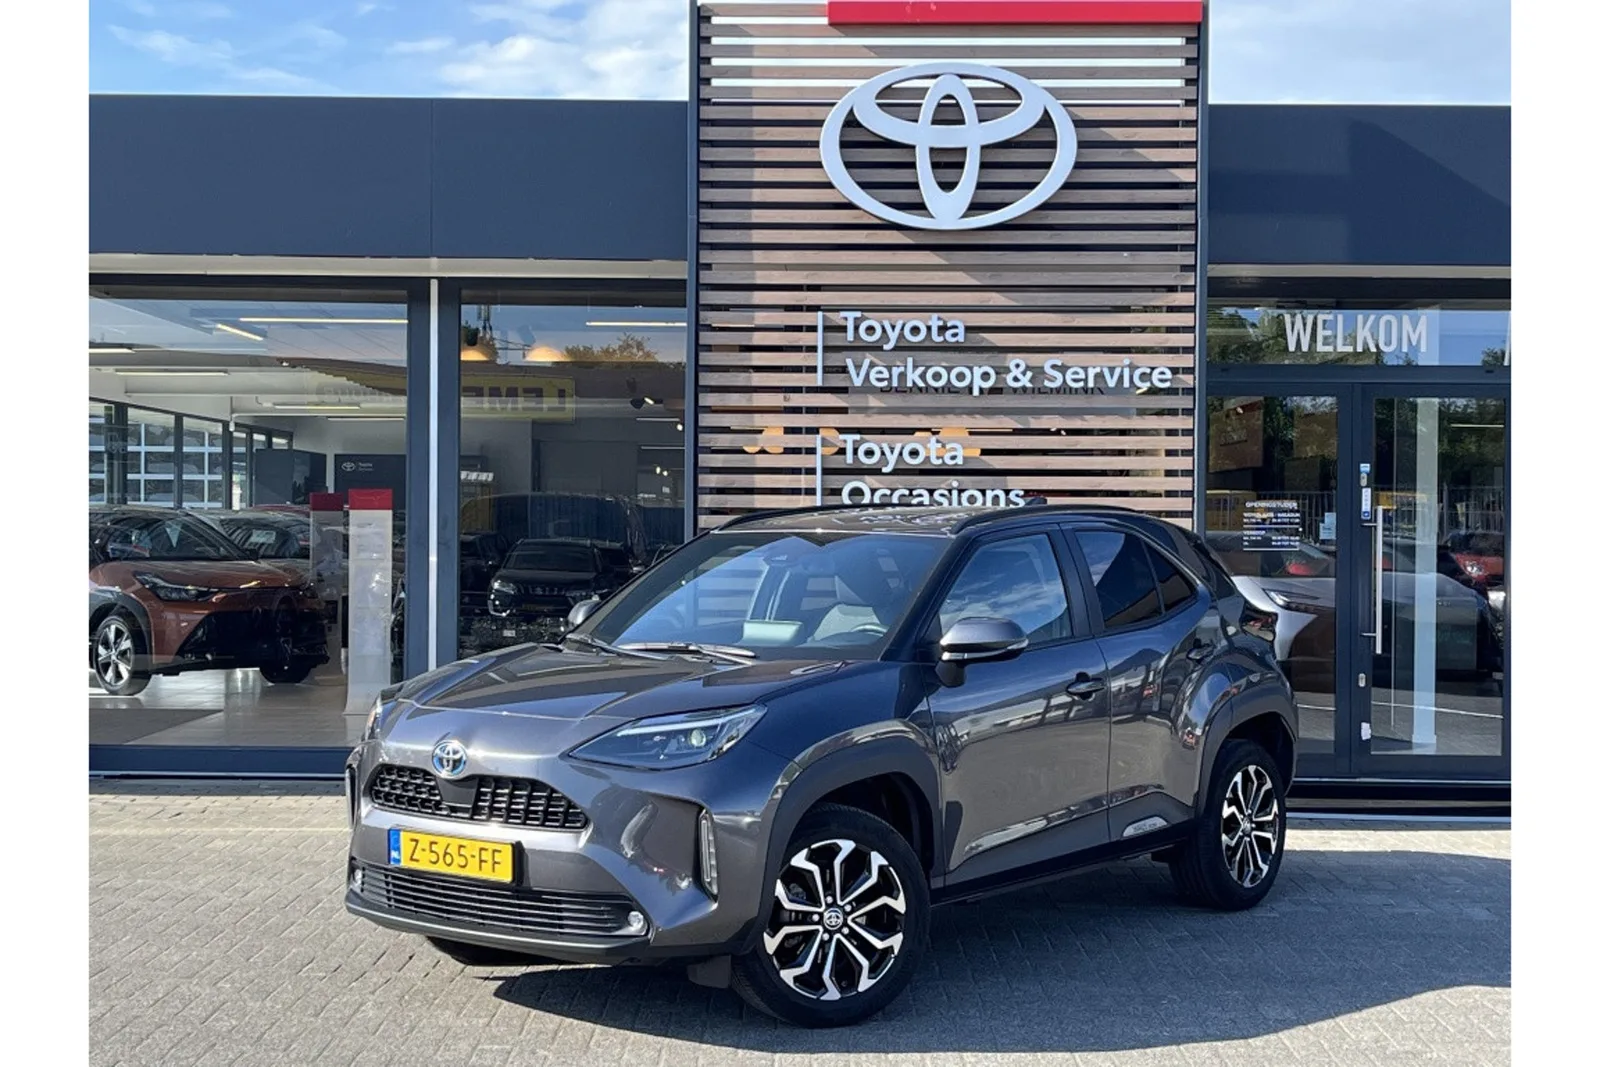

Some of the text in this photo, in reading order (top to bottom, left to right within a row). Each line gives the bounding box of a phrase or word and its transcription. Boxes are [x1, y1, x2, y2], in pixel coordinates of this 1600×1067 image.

[839, 311, 966, 351] Toyota
[1284, 313, 1428, 353] WELKOM
[845, 357, 1173, 397] Verkoop & Service
[839, 434, 964, 474] Toyota
[841, 480, 1026, 508] Occasions
[409, 838, 502, 873] Z-565-FF
